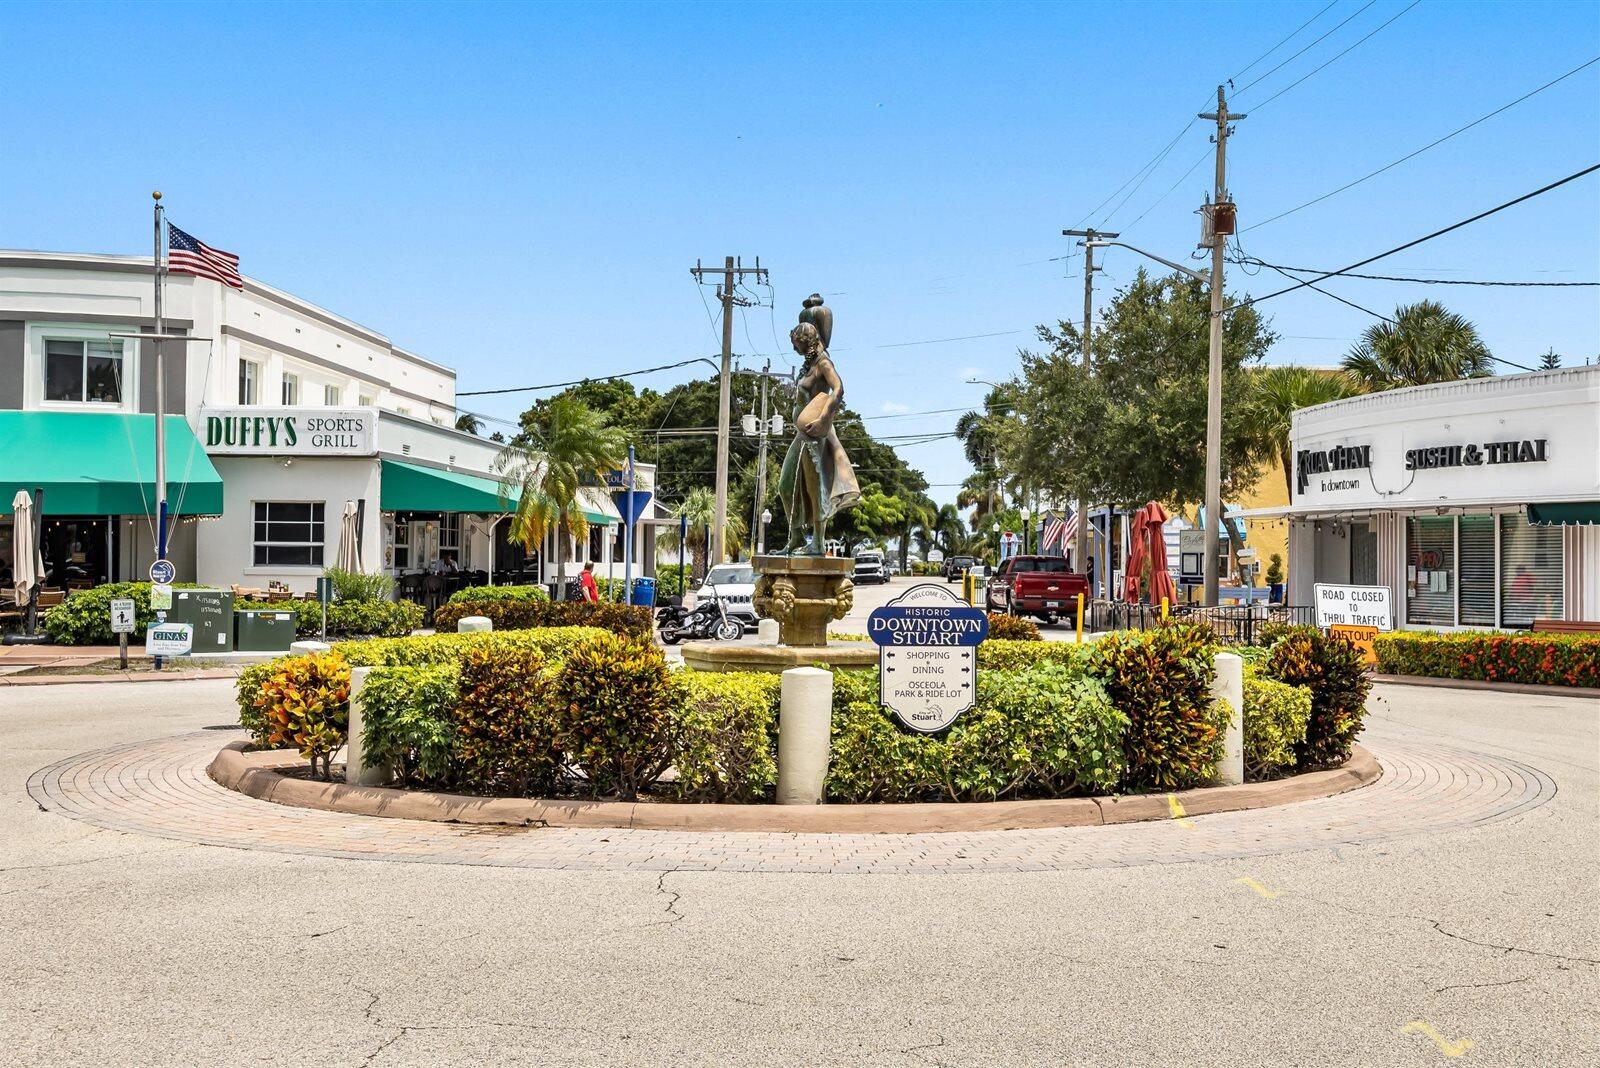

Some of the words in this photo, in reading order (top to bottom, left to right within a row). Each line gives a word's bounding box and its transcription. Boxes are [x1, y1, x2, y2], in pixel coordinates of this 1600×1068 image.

[206, 416, 297, 447] DUFFY'S
[307, 418, 363, 432] SPORTS
[311, 434, 358, 448] GRILL
[1328, 445, 1371, 471] THAI
[1405, 445, 1463, 471] SUSHI
[1463, 444, 1483, 466] &
[1484, 439, 1547, 465] THAI
[1327, 479, 1360, 492] downtown
[910, 590, 939, 601] WELCOME
[939, 592, 948, 601] TO
[1322, 589, 1345, 601] ROAD
[1351, 591, 1384, 602] CLOSED
[905, 608, 951, 616] HISTORIC
[1349, 603, 1358, 612] TO
[873, 617, 983, 633] DOWNTOWN
[1323, 613, 1345, 624] THRU
[1352, 614, 1386, 626] TRAFFIC
[892, 631, 963, 645] STUART
[906, 651, 950, 660] SHOPPING
[912, 666, 945, 674] DINING
[908, 681, 947, 689] OSCEOLA
[894, 690, 916, 698] PARK
[917, 690, 924, 698] &
[925, 690, 944, 698] RIDE
[946, 690, 962, 698] LOT
[911, 713, 937, 721] Stuart
